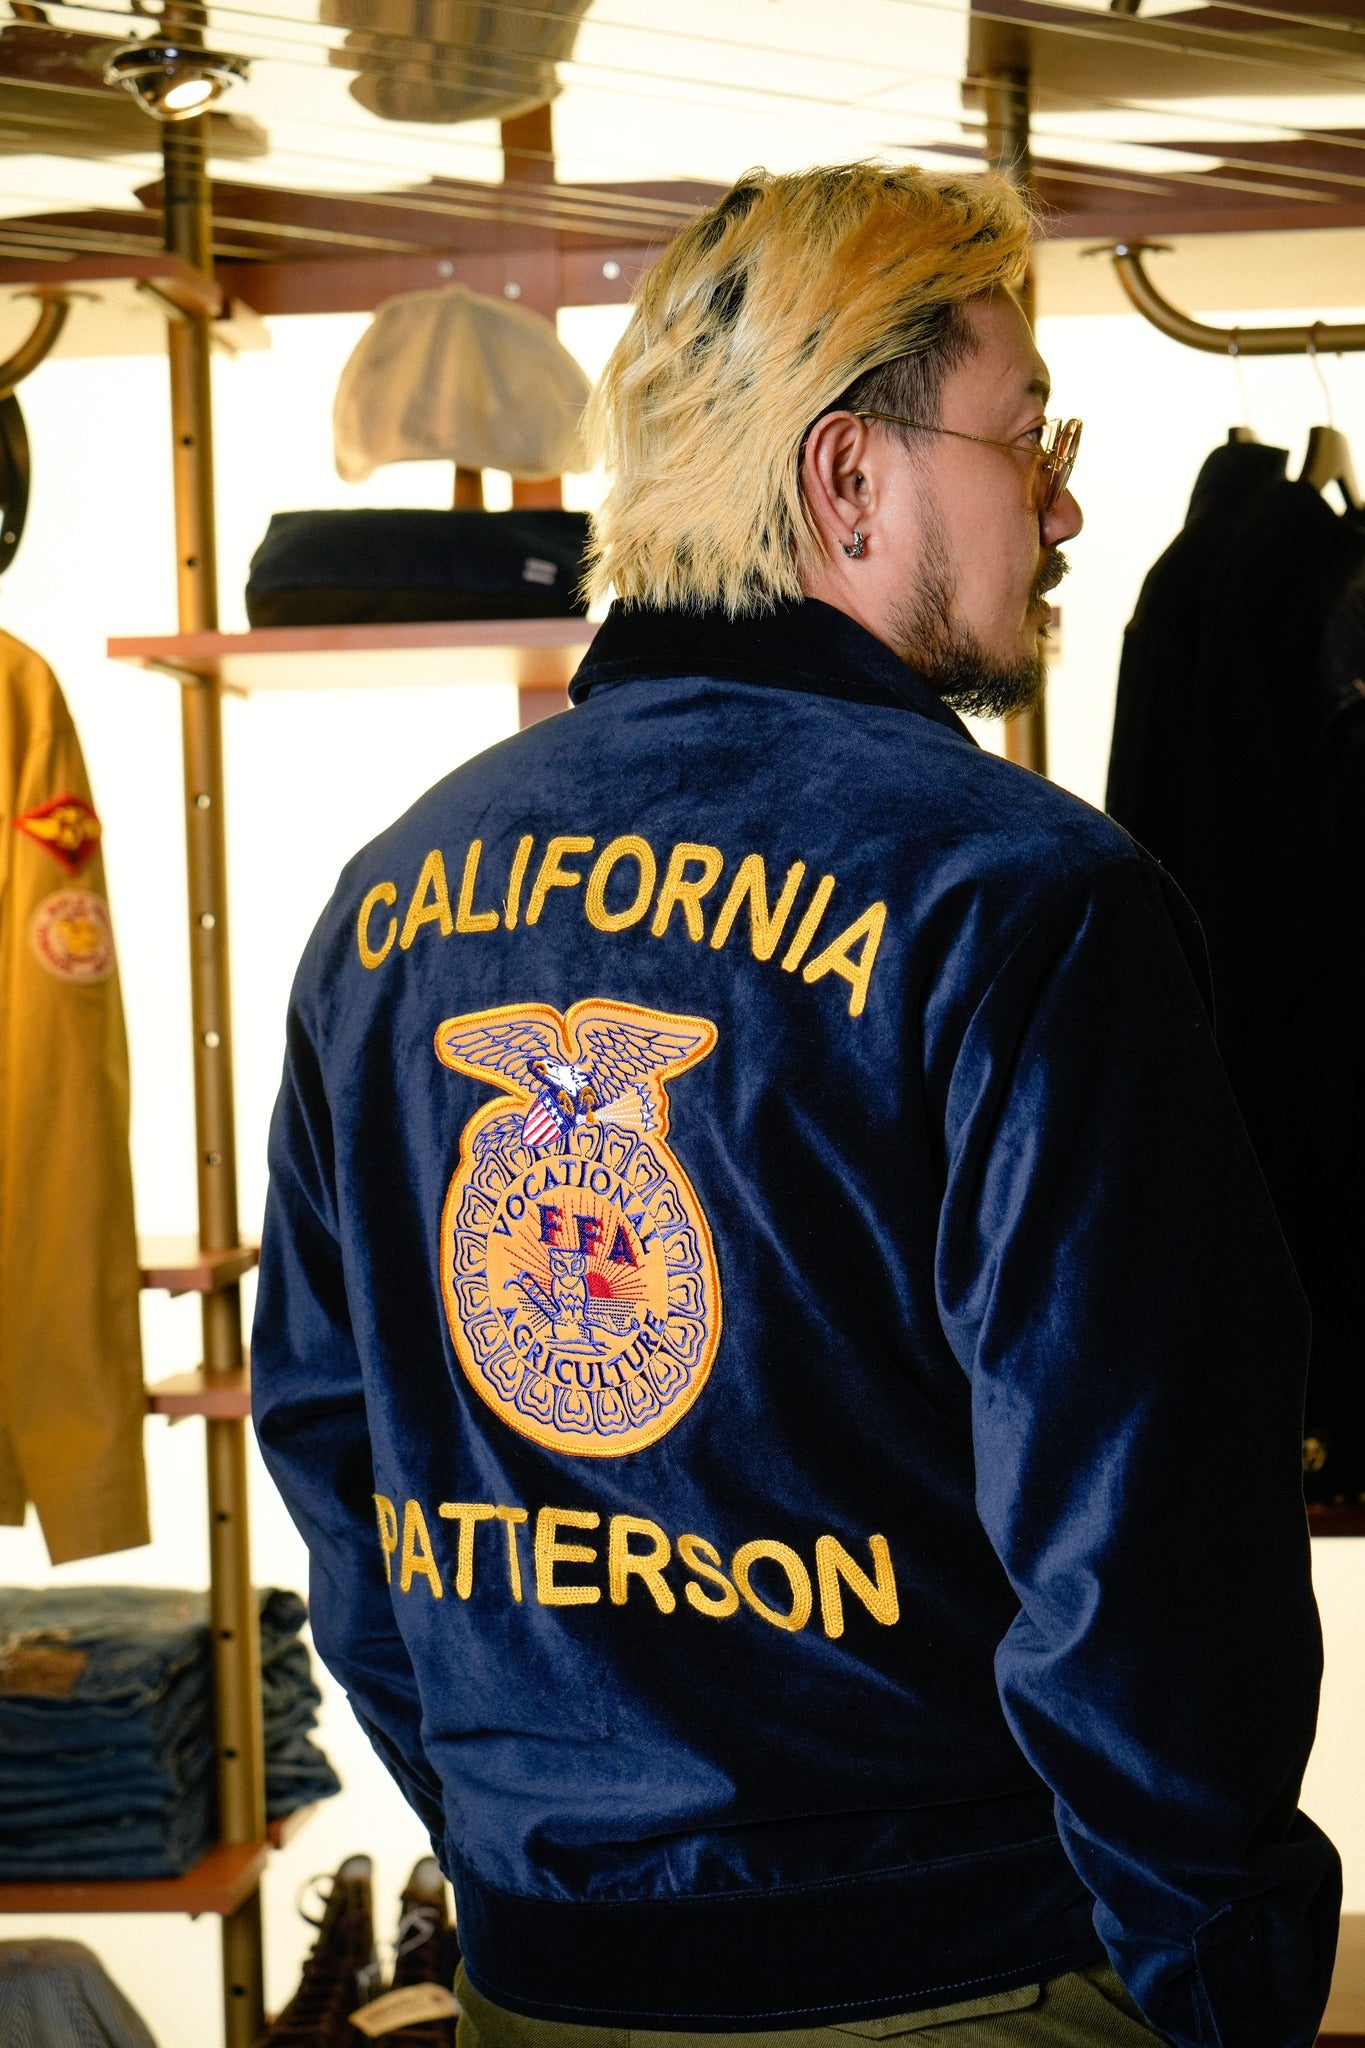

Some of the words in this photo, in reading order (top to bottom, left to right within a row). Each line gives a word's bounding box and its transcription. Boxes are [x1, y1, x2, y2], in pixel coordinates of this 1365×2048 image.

[357, 834, 887, 1018] CALIFORNIA
[492, 1159, 659, 1255] VOCATIONAL
[536, 1203, 638, 1268] FFA
[497, 1308, 665, 1389] AGRICULTURE
[372, 1493, 900, 1639] PATTERSON
